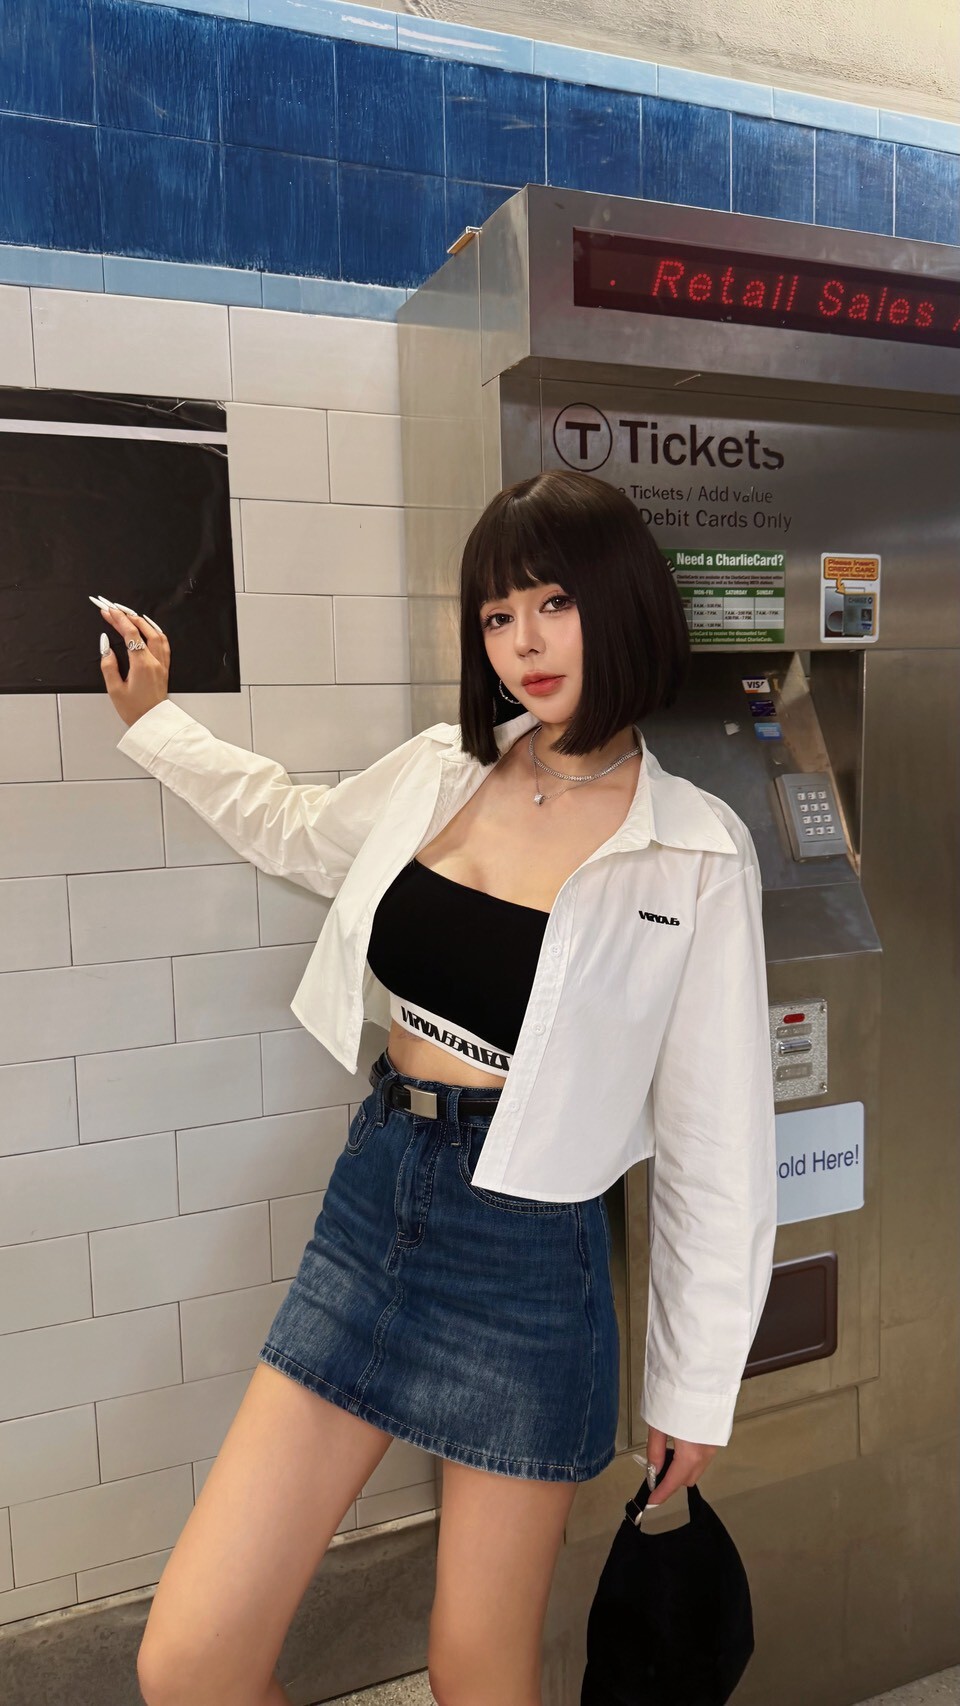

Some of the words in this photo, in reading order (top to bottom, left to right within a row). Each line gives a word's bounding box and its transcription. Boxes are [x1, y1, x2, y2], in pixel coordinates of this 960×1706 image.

[652, 259, 799, 312] Retail
[818, 280, 935, 327] Sales
[619, 420, 785, 470] Tickets
[630, 485, 684, 501] Tickets
[698, 486, 729, 502] Add
[640, 508, 690, 527] Debit
[696, 510, 748, 529] Cards
[753, 511, 793, 532] Only
[676, 552, 704, 566] Need
[706, 555, 713, 566] a
[715, 553, 784, 567] CharlieCard?
[776, 1153, 806, 1179] old
[812, 1144, 859, 1173] Here!
